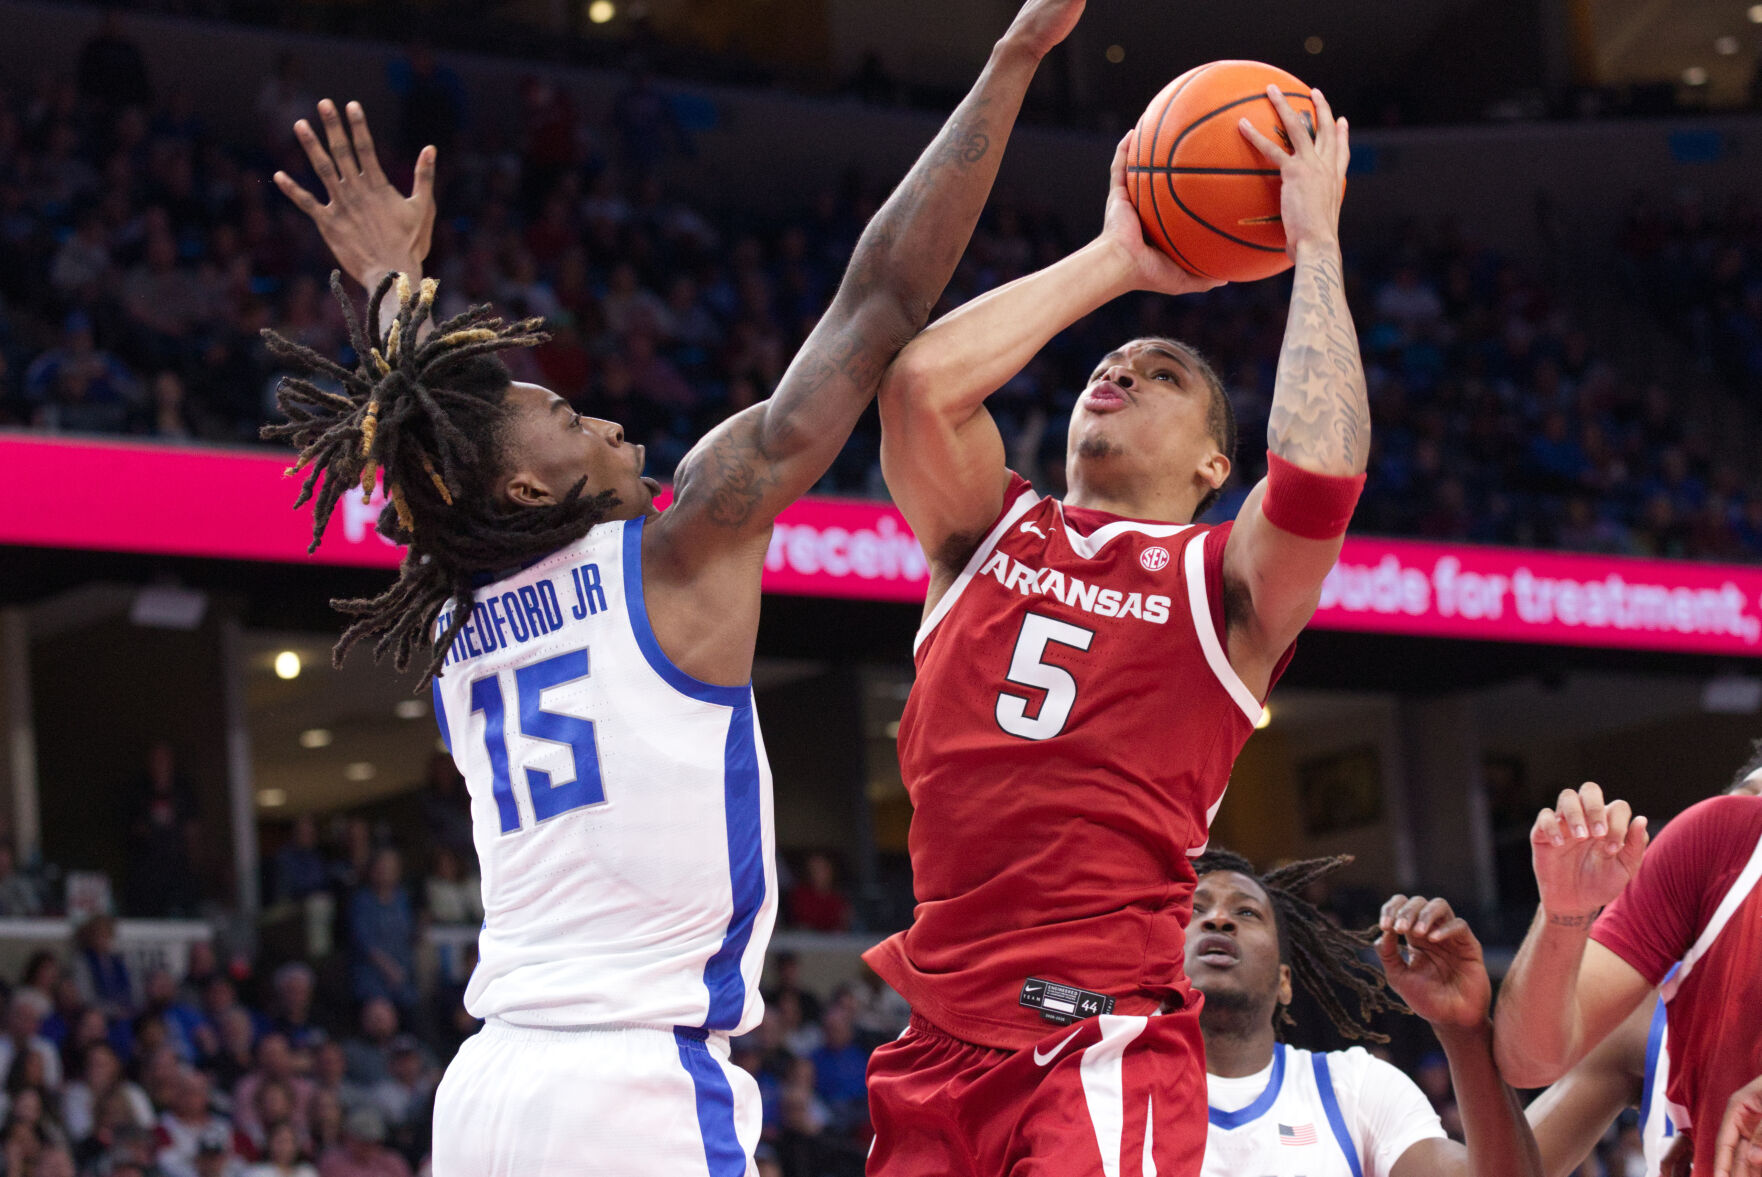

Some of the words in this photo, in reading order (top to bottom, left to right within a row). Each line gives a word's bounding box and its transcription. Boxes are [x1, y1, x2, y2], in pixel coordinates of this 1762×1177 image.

[571, 562, 609, 621] JR
[764, 514, 931, 583] receiv
[1433, 554, 1508, 621] for
[1511, 565, 1761, 646] treatment,
[979, 549, 1171, 624] ARKANSAS
[1142, 547, 1169, 570] SEC
[994, 609, 1096, 741] 5
[470, 645, 608, 836] 15
[1023, 994, 1041, 1002] TEAM
[1081, 1000, 1098, 1013] 44
